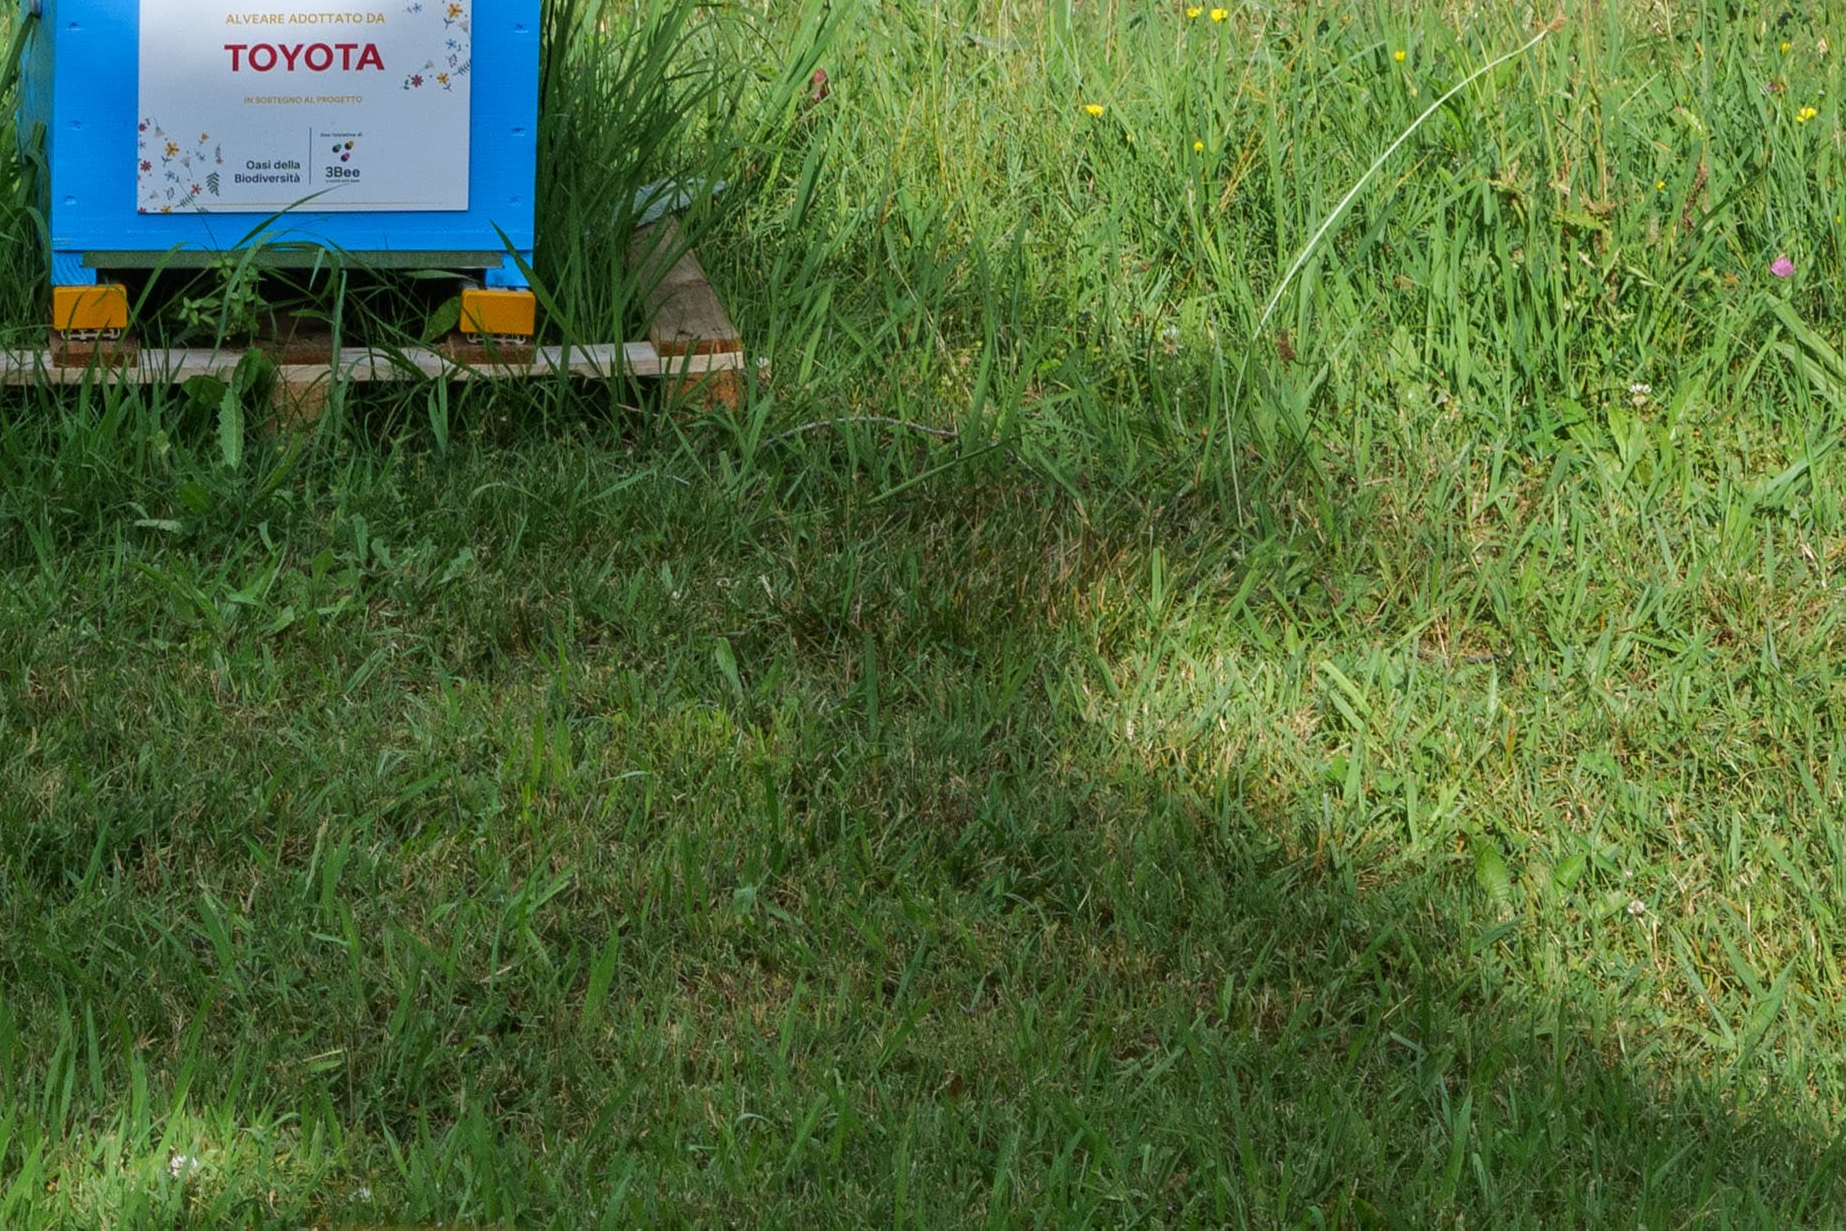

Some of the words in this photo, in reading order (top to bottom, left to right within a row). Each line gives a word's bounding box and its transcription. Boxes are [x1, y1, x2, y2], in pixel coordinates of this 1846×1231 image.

[226, 14, 284, 24] ALVEARE
[288, 13, 363, 24] ADOTTATO
[367, 13, 385, 24] DA
[224, 43, 385, 72] TOYOTA
[317, 96, 362, 104] PROGETTO
[246, 160, 271, 170] Oasi
[274, 160, 300, 170] della
[326, 166, 360, 178] 3Bee
[234, 173, 300, 183] Biodiversità
